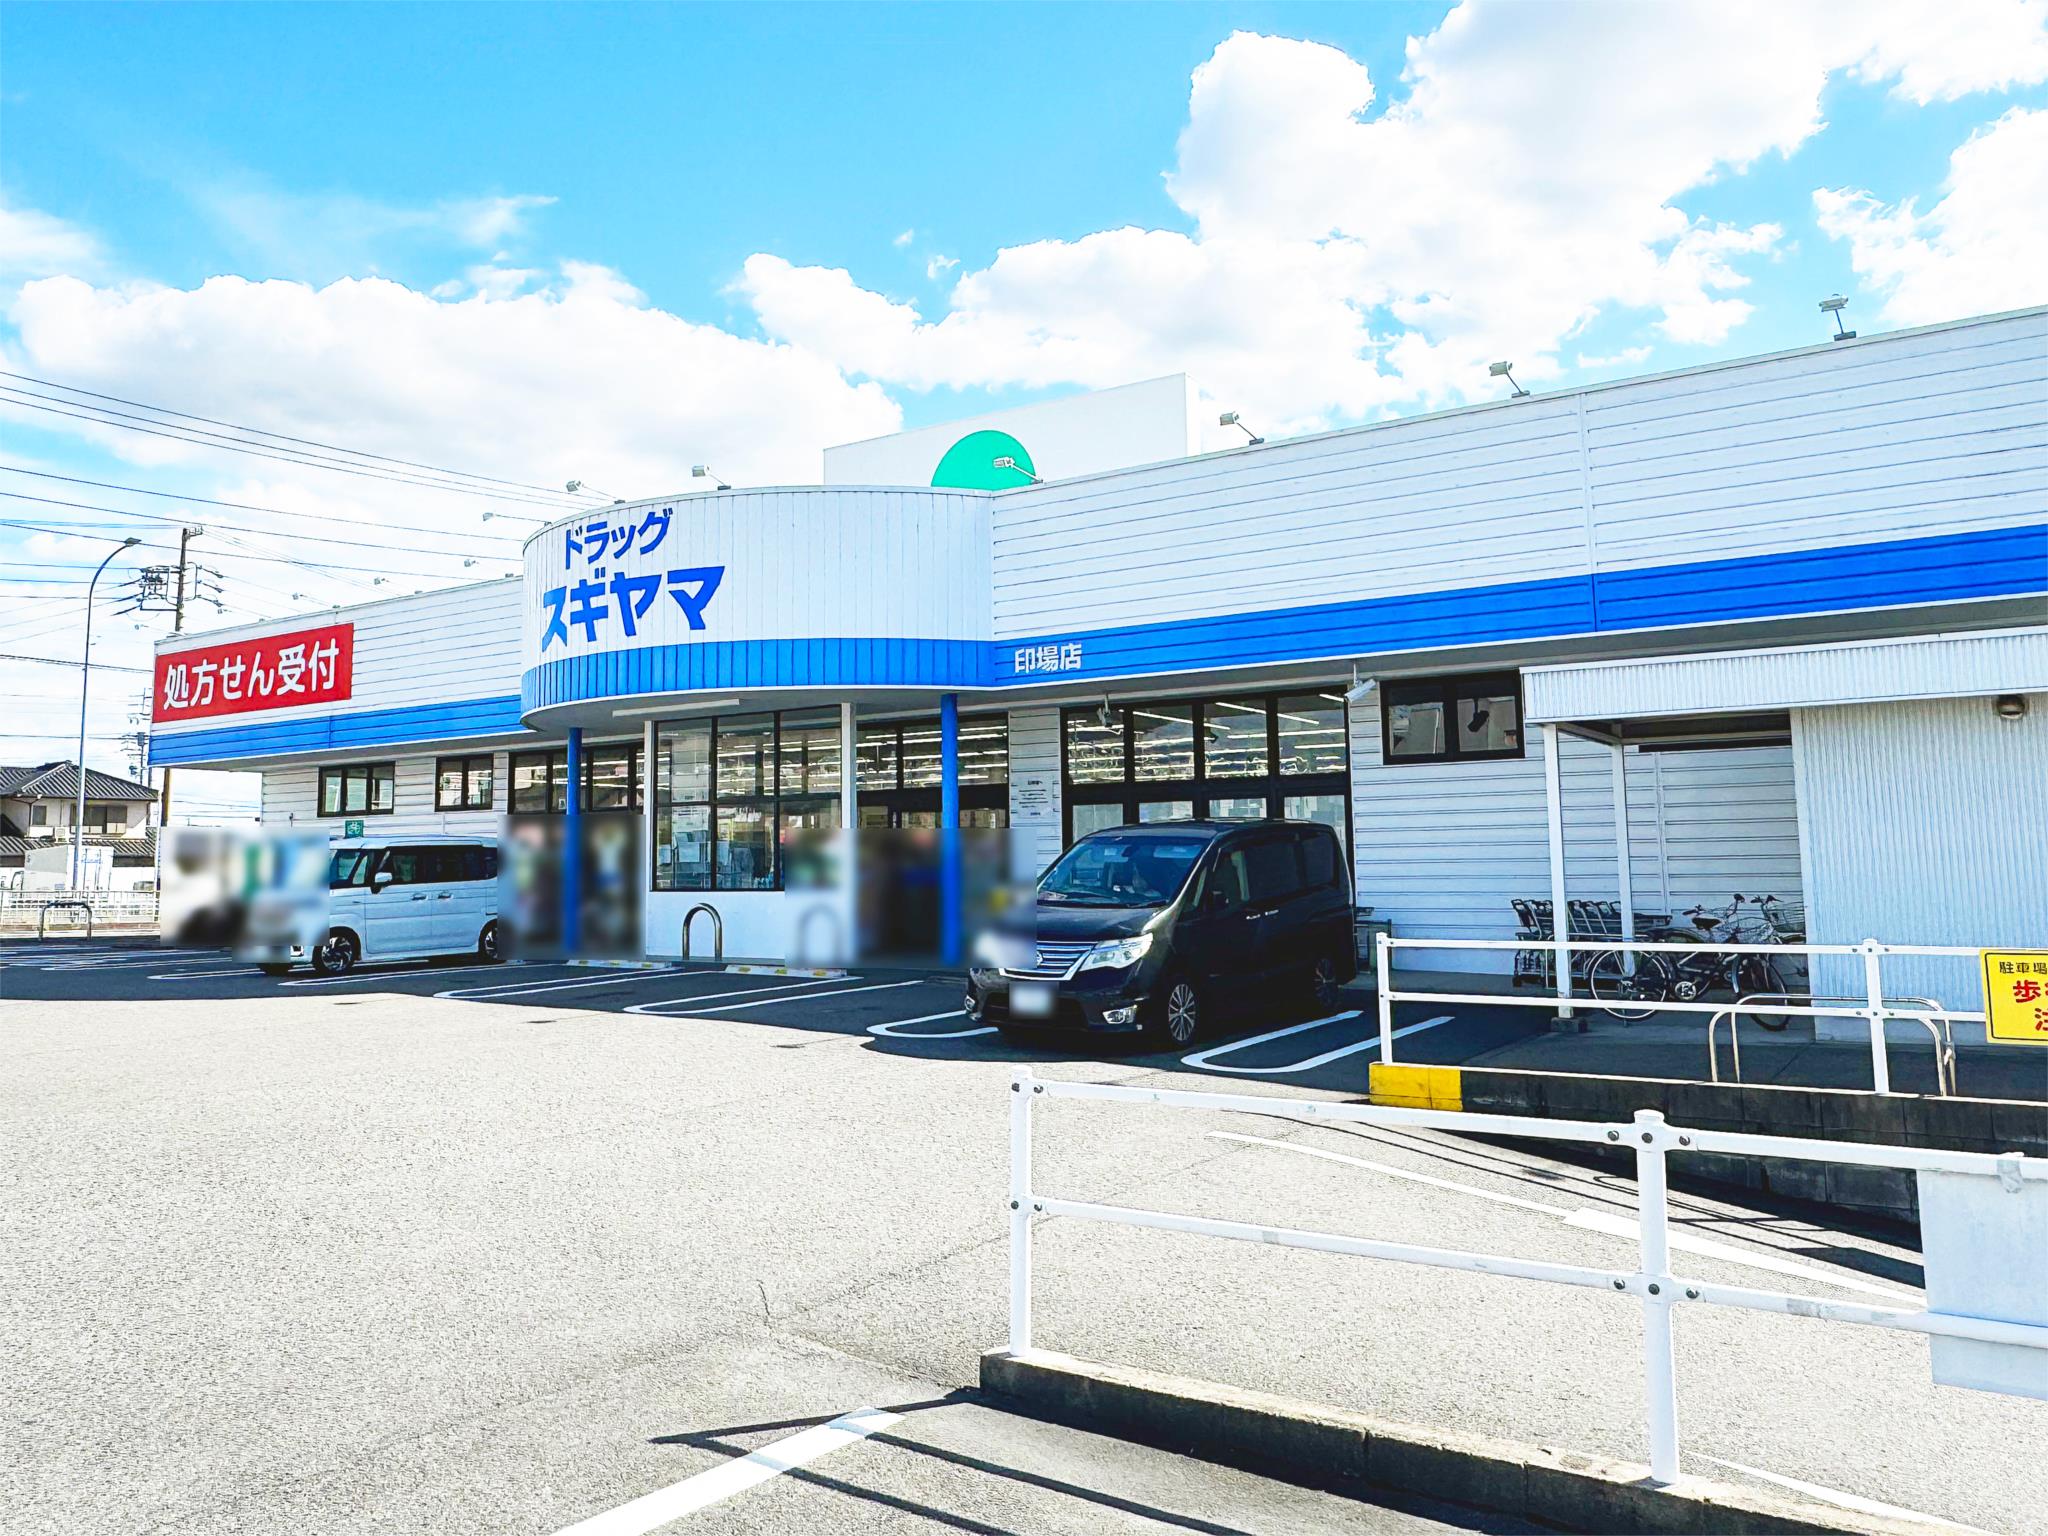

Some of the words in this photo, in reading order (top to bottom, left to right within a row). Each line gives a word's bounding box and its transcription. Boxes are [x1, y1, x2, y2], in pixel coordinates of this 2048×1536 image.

[566, 508, 673, 570] ドラッグ
[542, 567, 725, 652] スギヤマ
[164, 638, 340, 710] 処方せん受付
[1015, 643, 1082, 673] 印場店
[2012, 979, 2048, 1003] 歩
